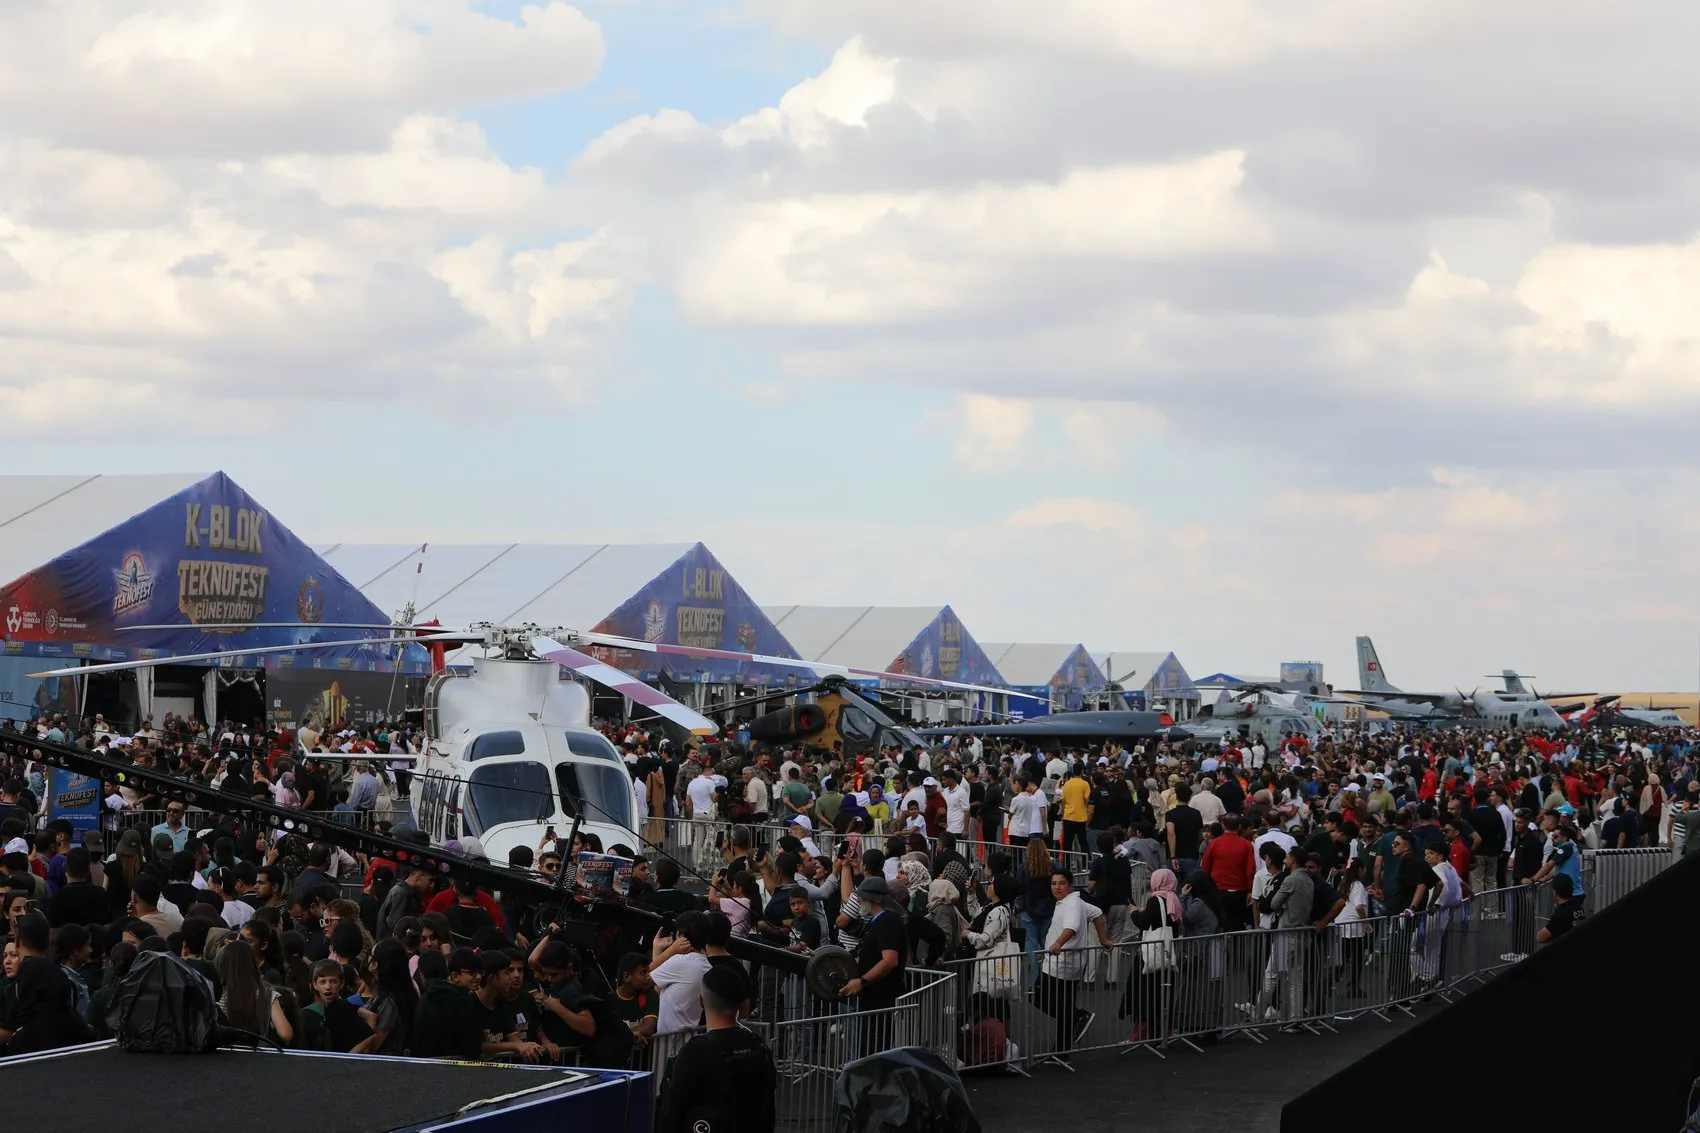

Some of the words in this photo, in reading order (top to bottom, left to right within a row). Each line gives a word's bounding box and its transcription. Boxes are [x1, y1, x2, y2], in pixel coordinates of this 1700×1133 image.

[185, 502, 263, 554] K-BLOK
[178, 560, 268, 599] TEKNOFEST
[683, 568, 723, 600] L-BLOK
[195, 599, 253, 620] GÜNEYDOĞU
[678, 606, 725, 632] TEKNOFEST
[57, 789, 96, 802] TEKNOFEST
